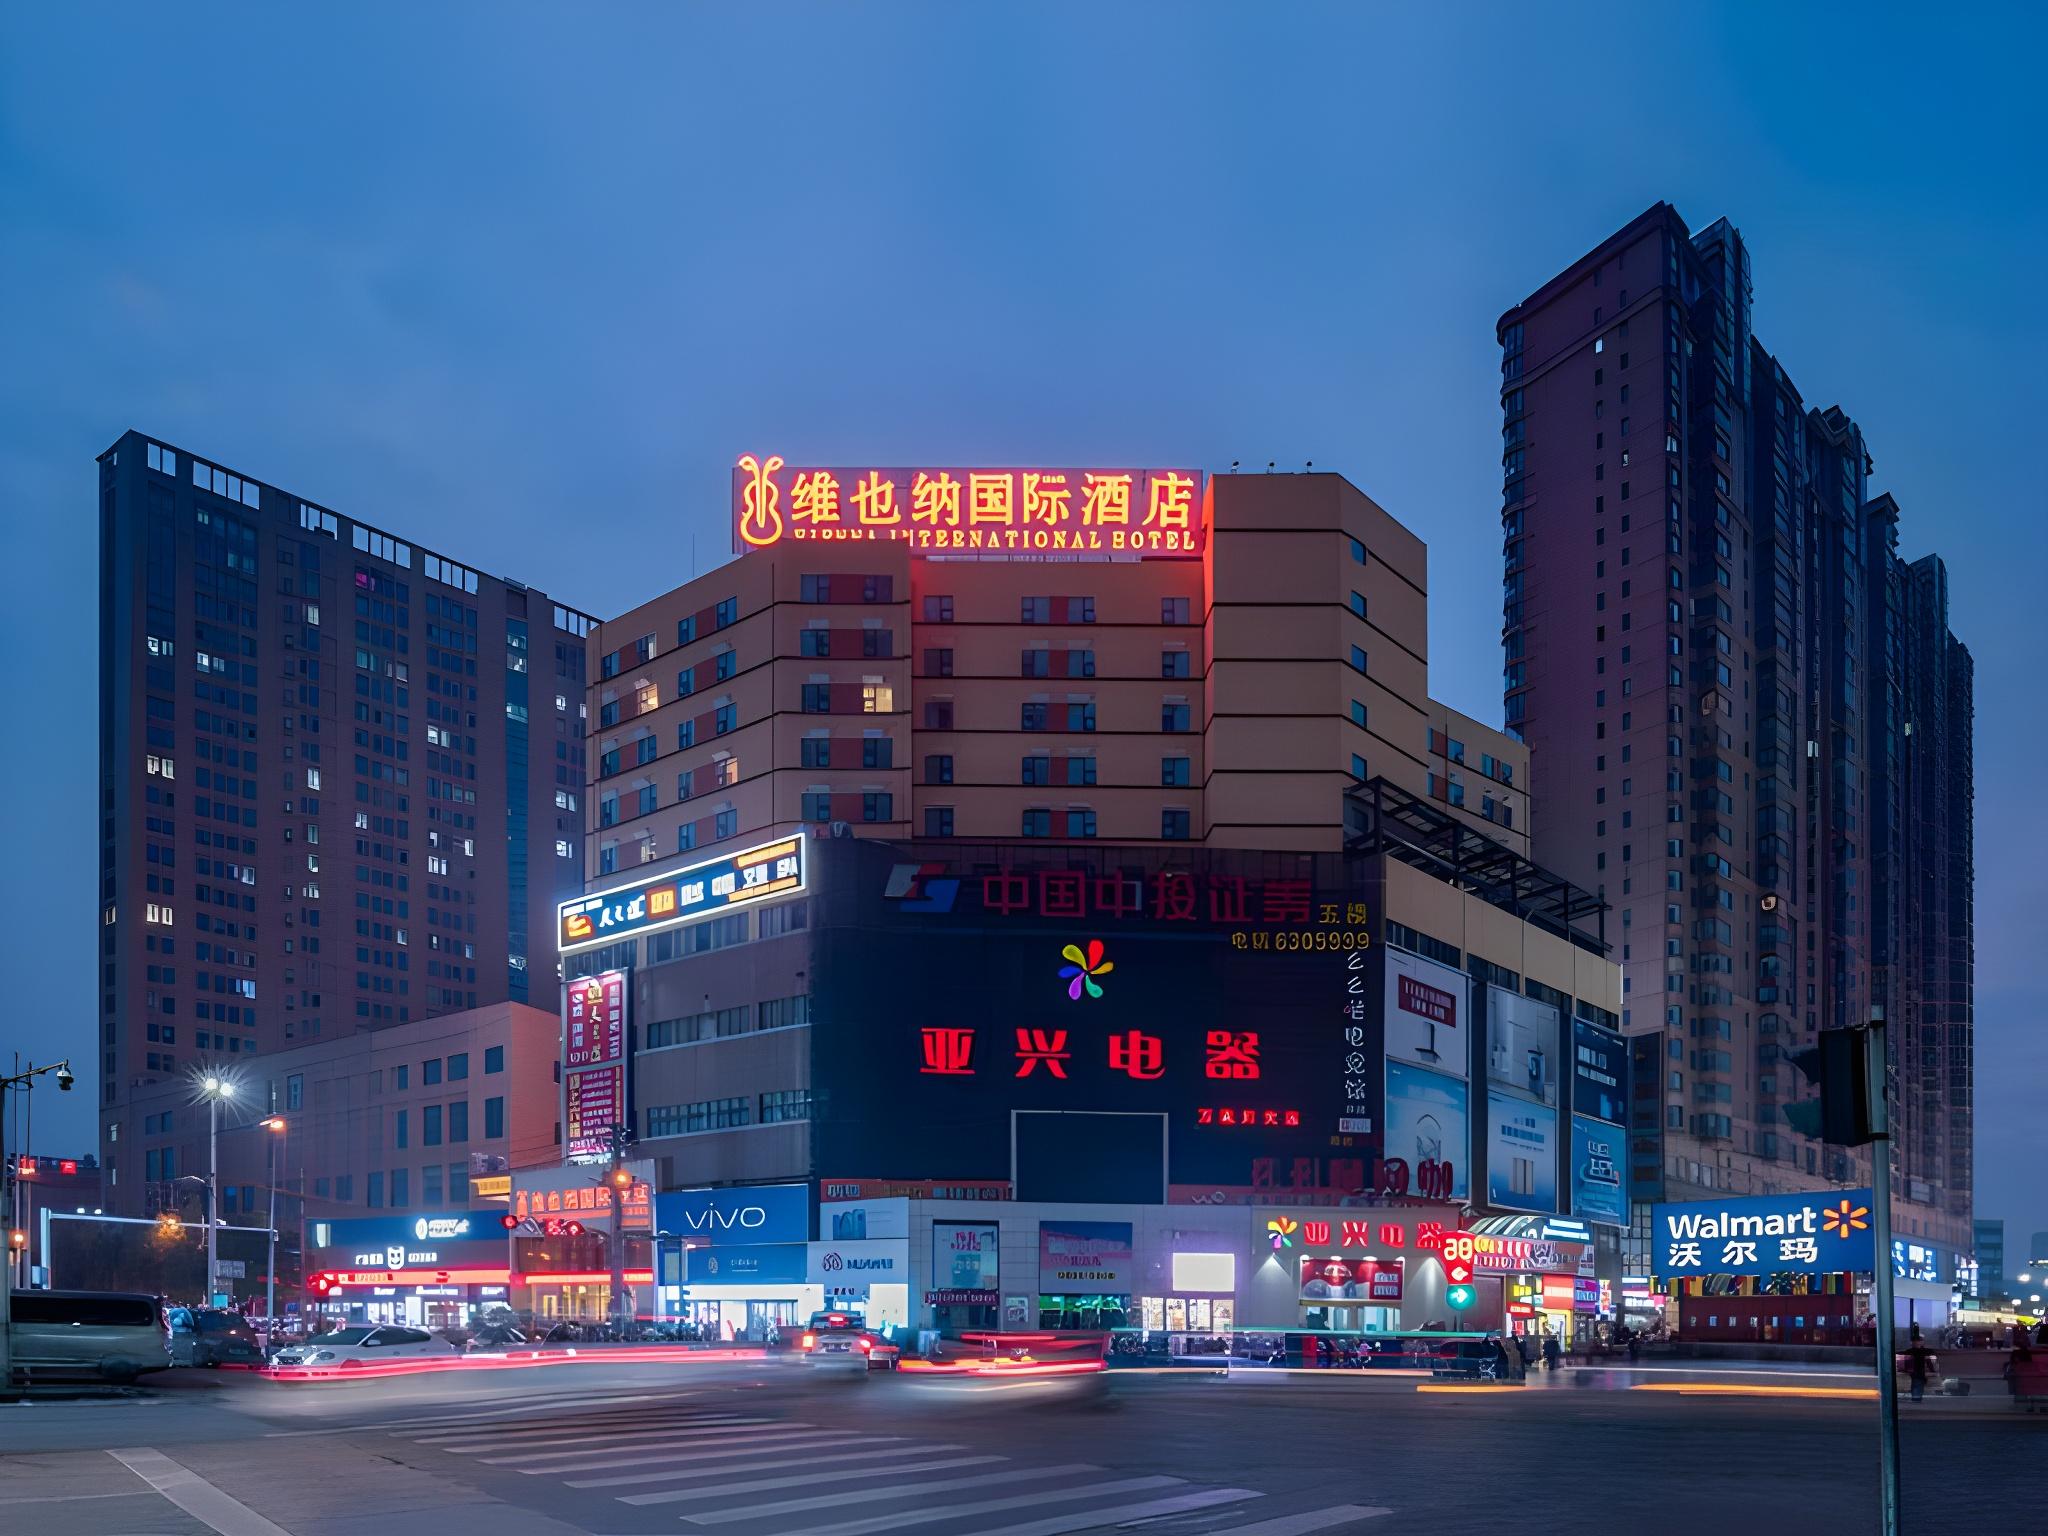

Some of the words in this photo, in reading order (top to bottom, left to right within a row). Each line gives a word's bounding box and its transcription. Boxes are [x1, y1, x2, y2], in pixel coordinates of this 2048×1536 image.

[790, 471, 1195, 528] 维也纳国际酒店
[920, 1028, 1260, 1079] 亚兴电器
[685, 1203, 766, 1230] vivo
[1667, 1206, 1817, 1240] Walmart
[1668, 1237, 1818, 1267] 沃尔玛
